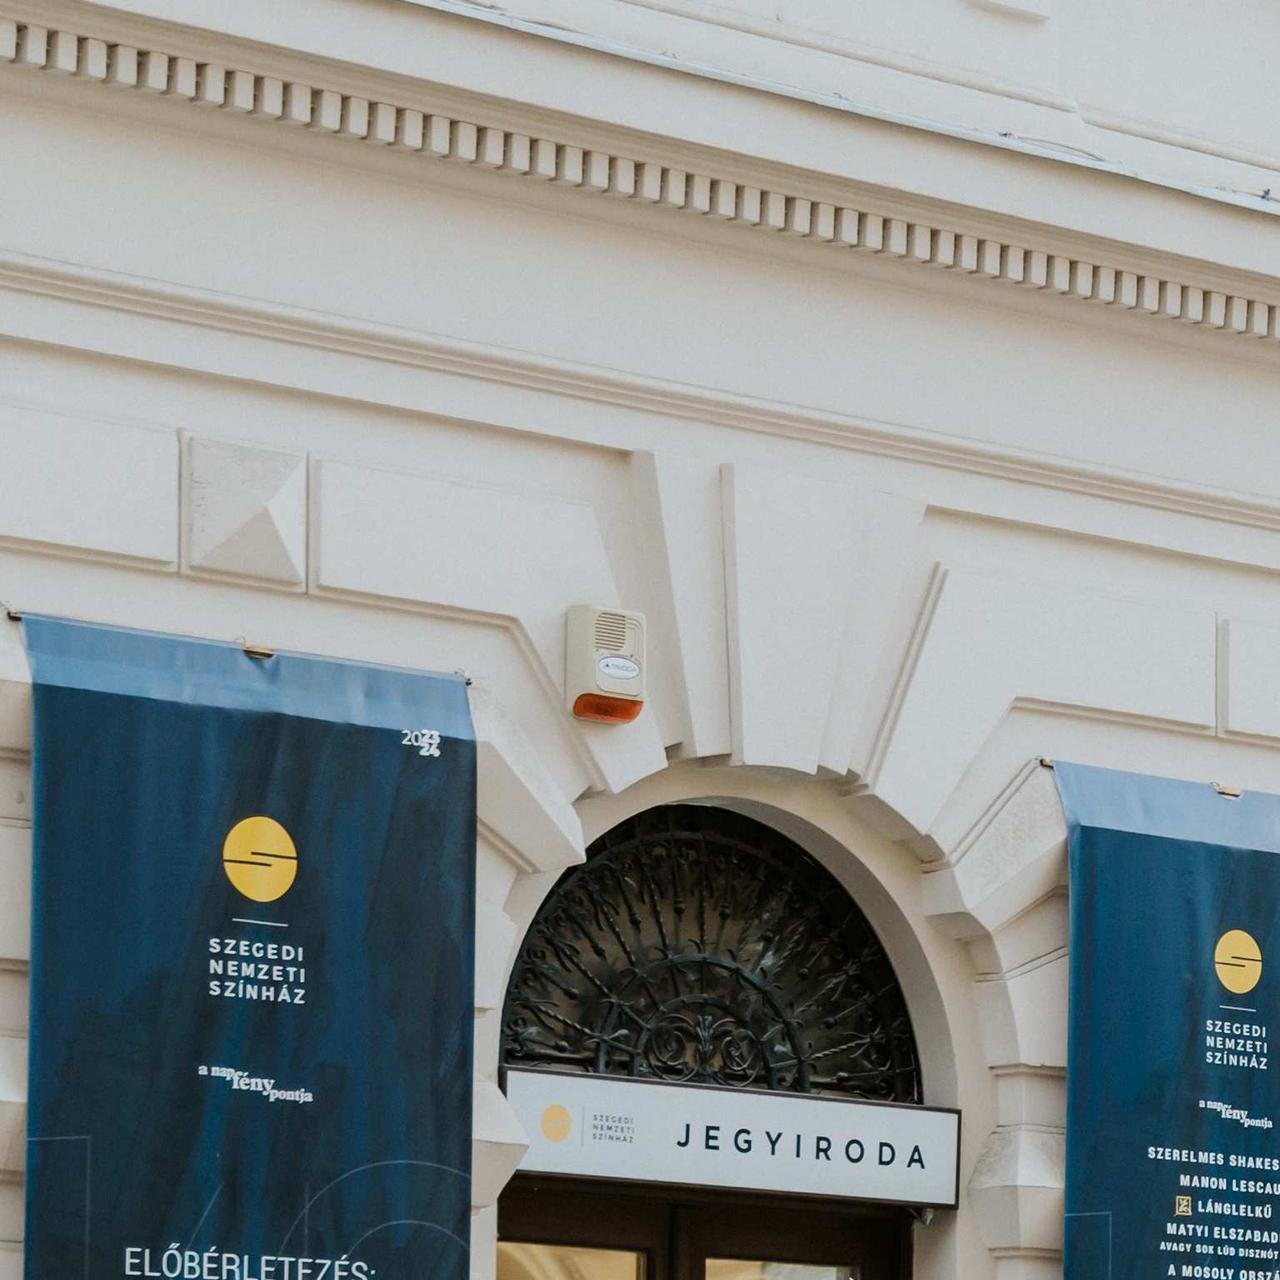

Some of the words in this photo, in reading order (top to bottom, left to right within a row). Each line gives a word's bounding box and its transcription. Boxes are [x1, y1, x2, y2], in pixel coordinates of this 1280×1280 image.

[209, 938, 305, 962] SZEGEDI
[210, 960, 305, 983] NEMZETI
[209, 979, 306, 1005] SZÍNHÁZ
[1206, 1020, 1266, 1038] SZEGEDI
[1206, 1036, 1268, 1053] NEMZETI
[1206, 1050, 1268, 1069] SZÍNHÁZ
[593, 1114, 633, 1124] SZEGEDI
[593, 1124, 635, 1133] NEMZETI
[676, 1123, 927, 1170] JEGYIRODA
[1147, 1147, 1224, 1165] SZERELMES
[1180, 1175, 1227, 1190] MANON
[1198, 1200, 1272, 1218] LÁNGLELKŰ
[1167, 1223, 1209, 1238] MATYI
[1160, 1242, 1191, 1252] AVAGY
[1196, 1244, 1214, 1254] SOK
[1218, 1245, 1235, 1257] LÚD
[1239, 1246, 1279, 1260] DISZNÓT
[1168, 1265, 1176, 1276] A
[1182, 1266, 1234, 1280] MOSOLY
